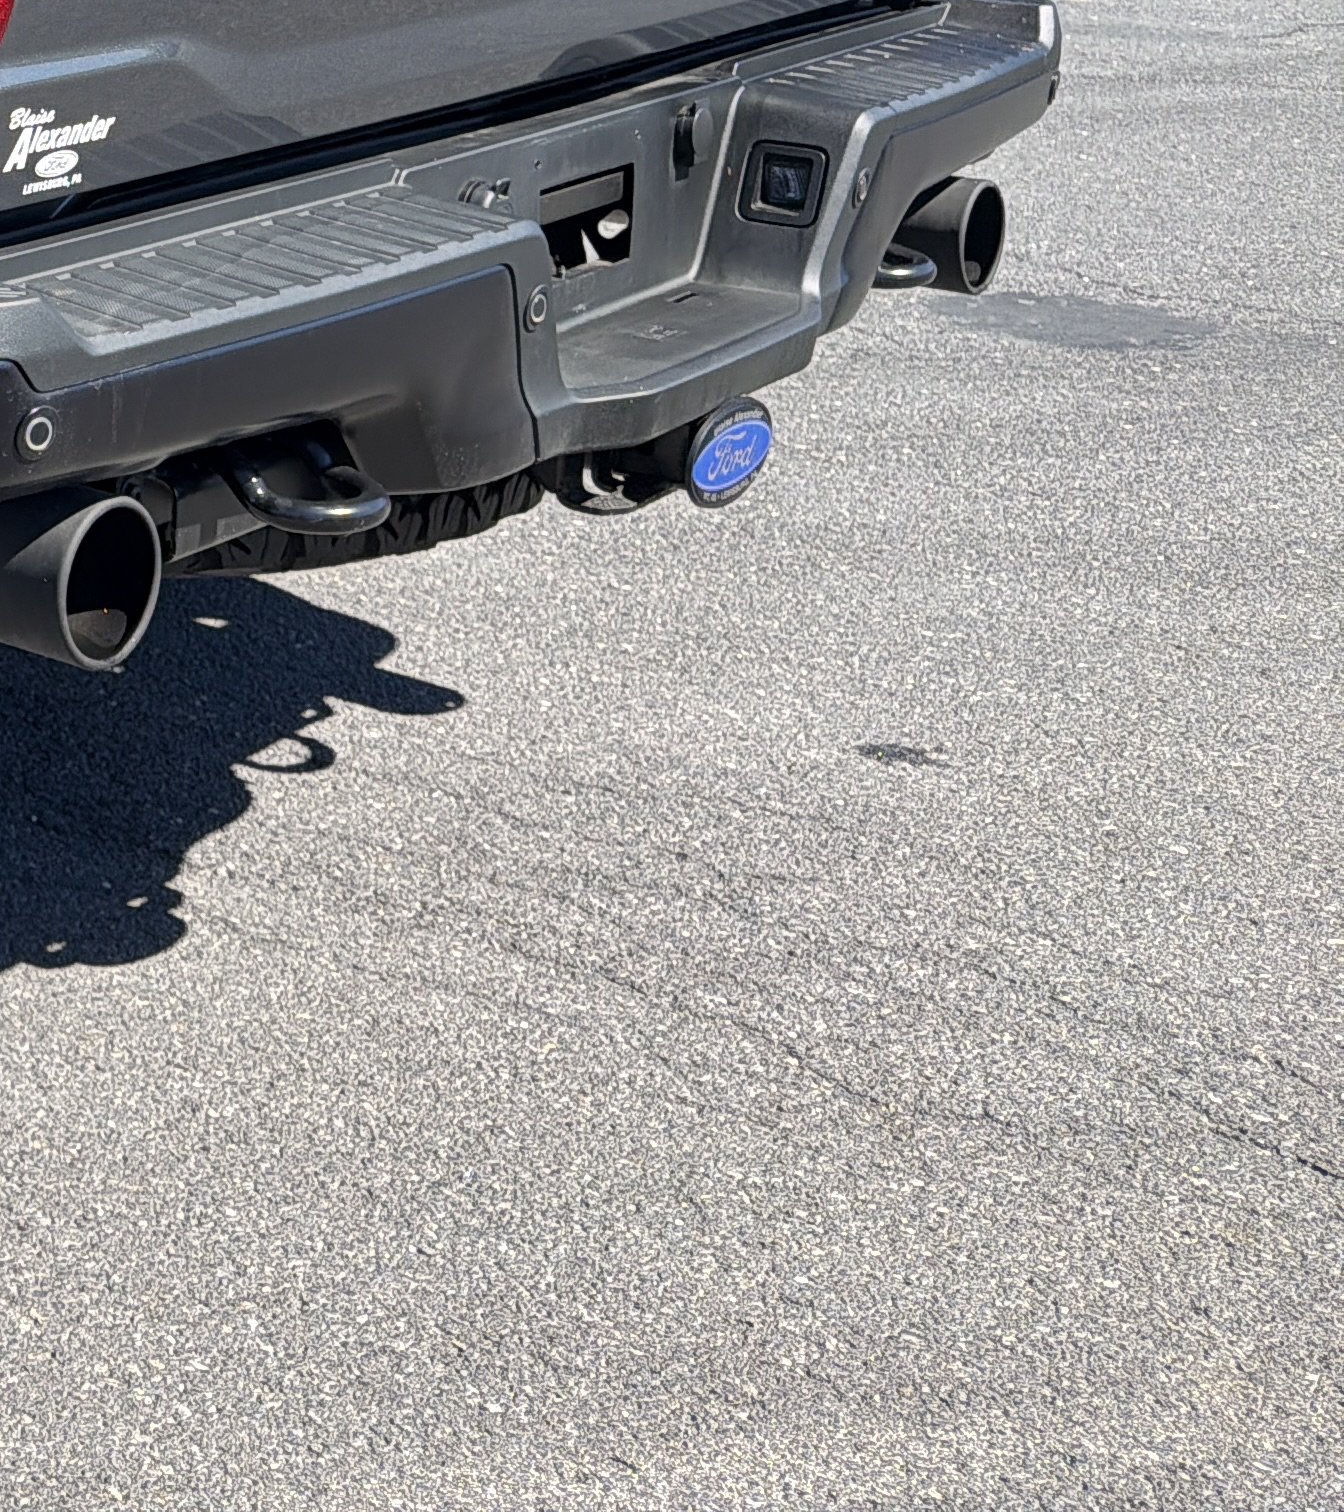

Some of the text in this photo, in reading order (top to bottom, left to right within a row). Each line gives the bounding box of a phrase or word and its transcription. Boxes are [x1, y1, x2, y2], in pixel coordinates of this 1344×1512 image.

[9, 107, 56, 129] Blaise
[2, 114, 116, 174] Alexander
[708, 430, 759, 481] Ford
